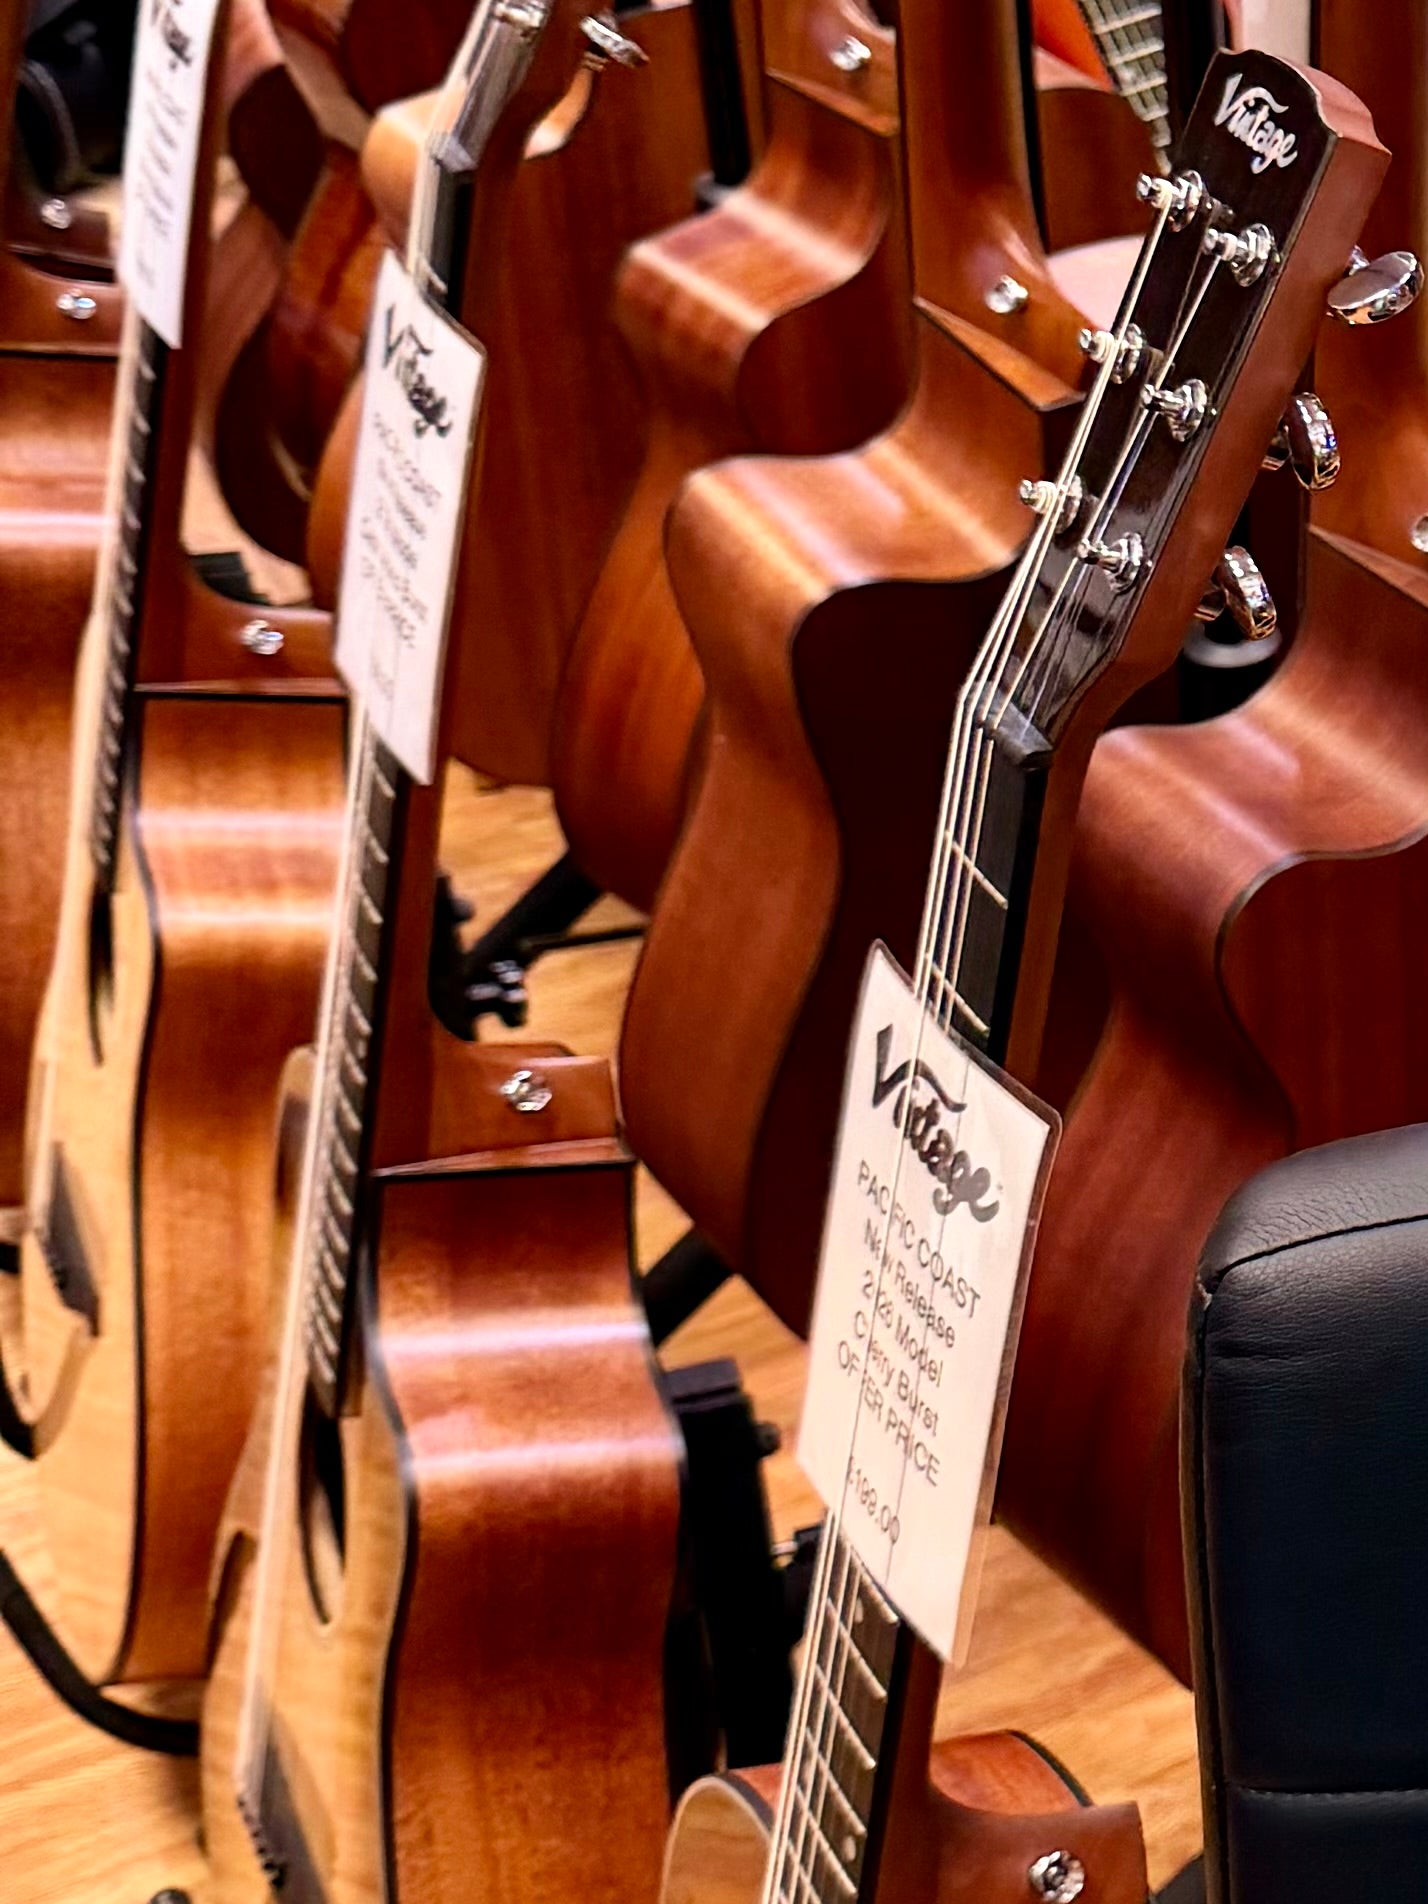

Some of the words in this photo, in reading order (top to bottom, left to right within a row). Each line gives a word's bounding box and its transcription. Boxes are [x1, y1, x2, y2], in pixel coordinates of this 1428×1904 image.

[1214, 73, 1298, 174] Vintage
[872, 1023, 999, 1223] Vintage
[857, 1159, 915, 1249] PACFIC
[917, 1238, 981, 1319] COAST
[894, 1314, 943, 1390] Model
[895, 1260, 955, 1348] Release
[838, 1340, 884, 1421] OFER
[885, 1405, 941, 1487] PRICE
[855, 1311, 893, 1389] Cerry
[898, 1369, 940, 1437] Burst
